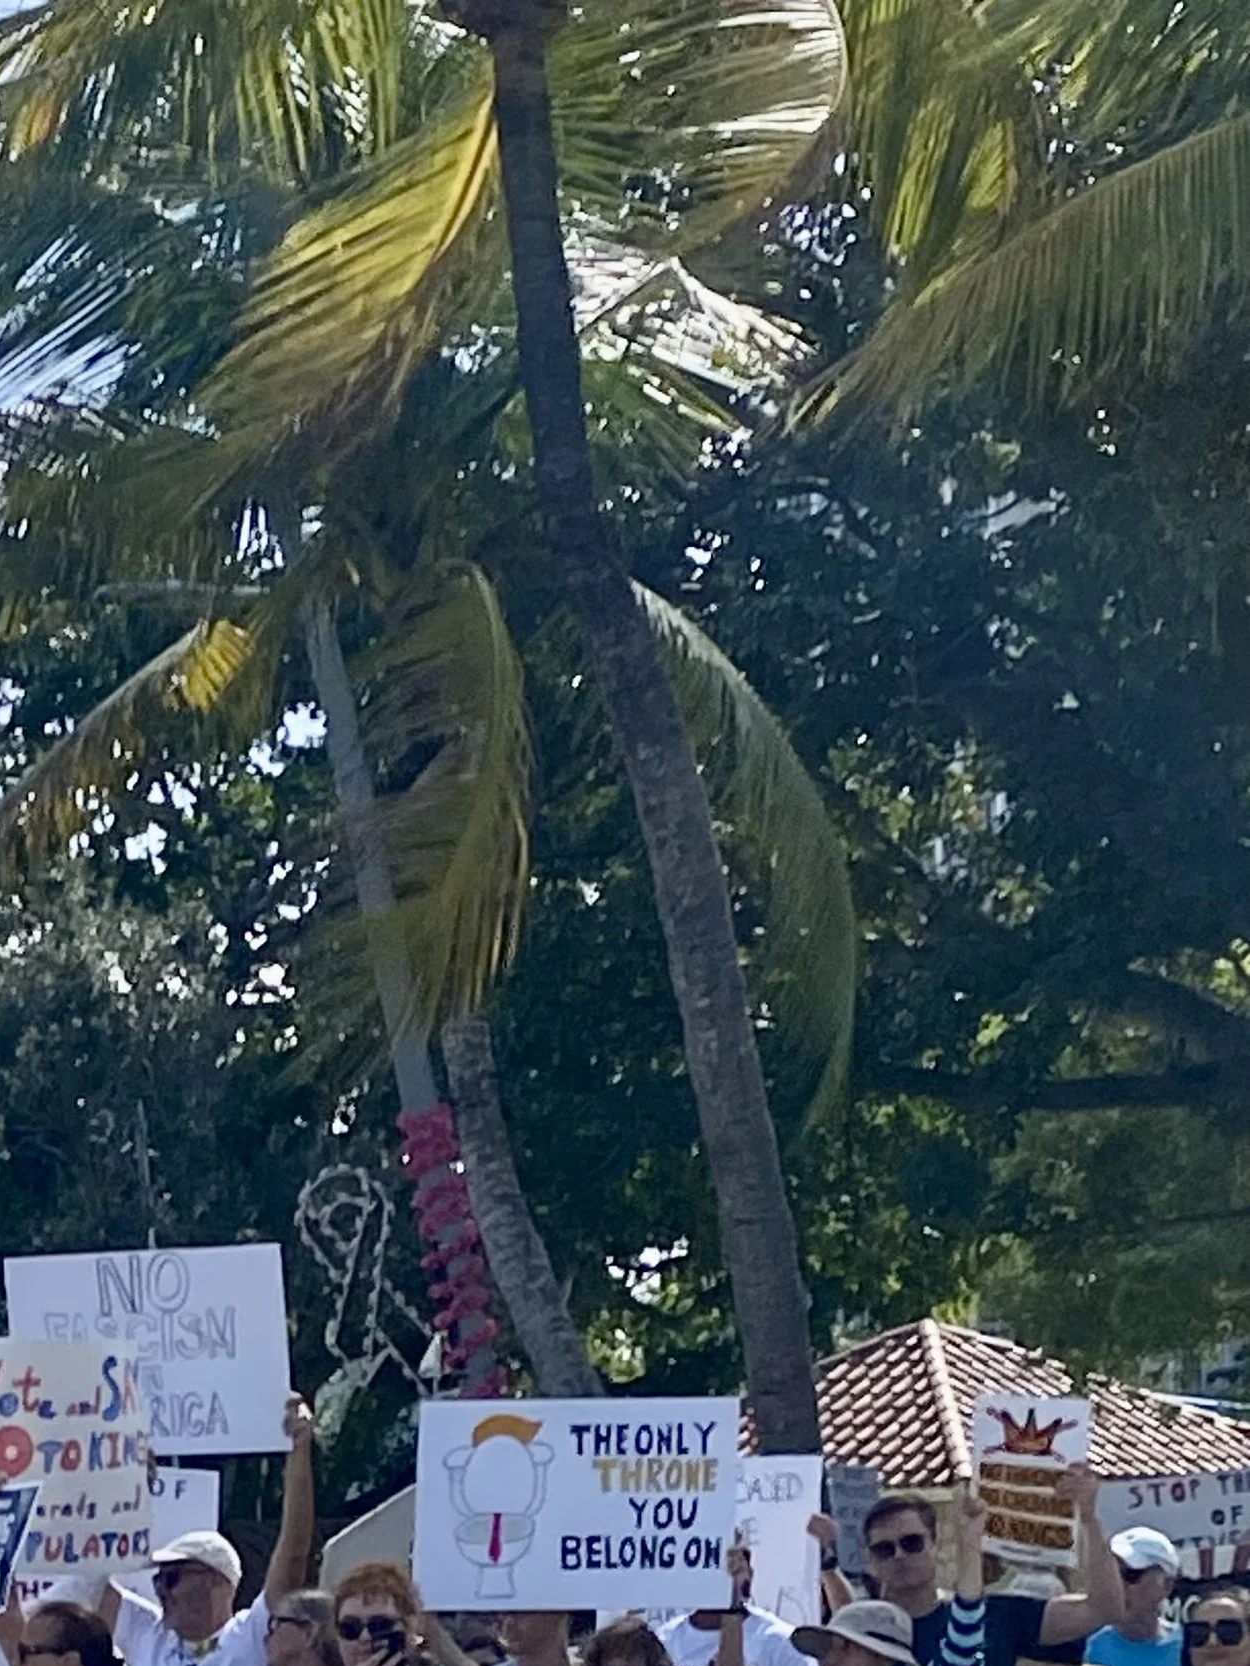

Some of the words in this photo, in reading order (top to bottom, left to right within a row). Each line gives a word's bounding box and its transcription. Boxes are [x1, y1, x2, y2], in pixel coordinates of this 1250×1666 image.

[95, 1252, 191, 1317] NO
[149, 1391, 230, 1437] RICA
[569, 1423, 630, 1456] THE
[634, 1421, 718, 1455] ONLY
[37, 1439, 81, 1474] TO
[592, 1458, 720, 1493] THRONE
[1127, 1478, 1200, 1510] STOP
[628, 1497, 699, 1529] YOU
[1210, 1504, 1244, 1527] OF
[25, 1527, 150, 1563] PULATORS
[560, 1535, 677, 1571] BELONG
[682, 1536, 722, 1569] ON
